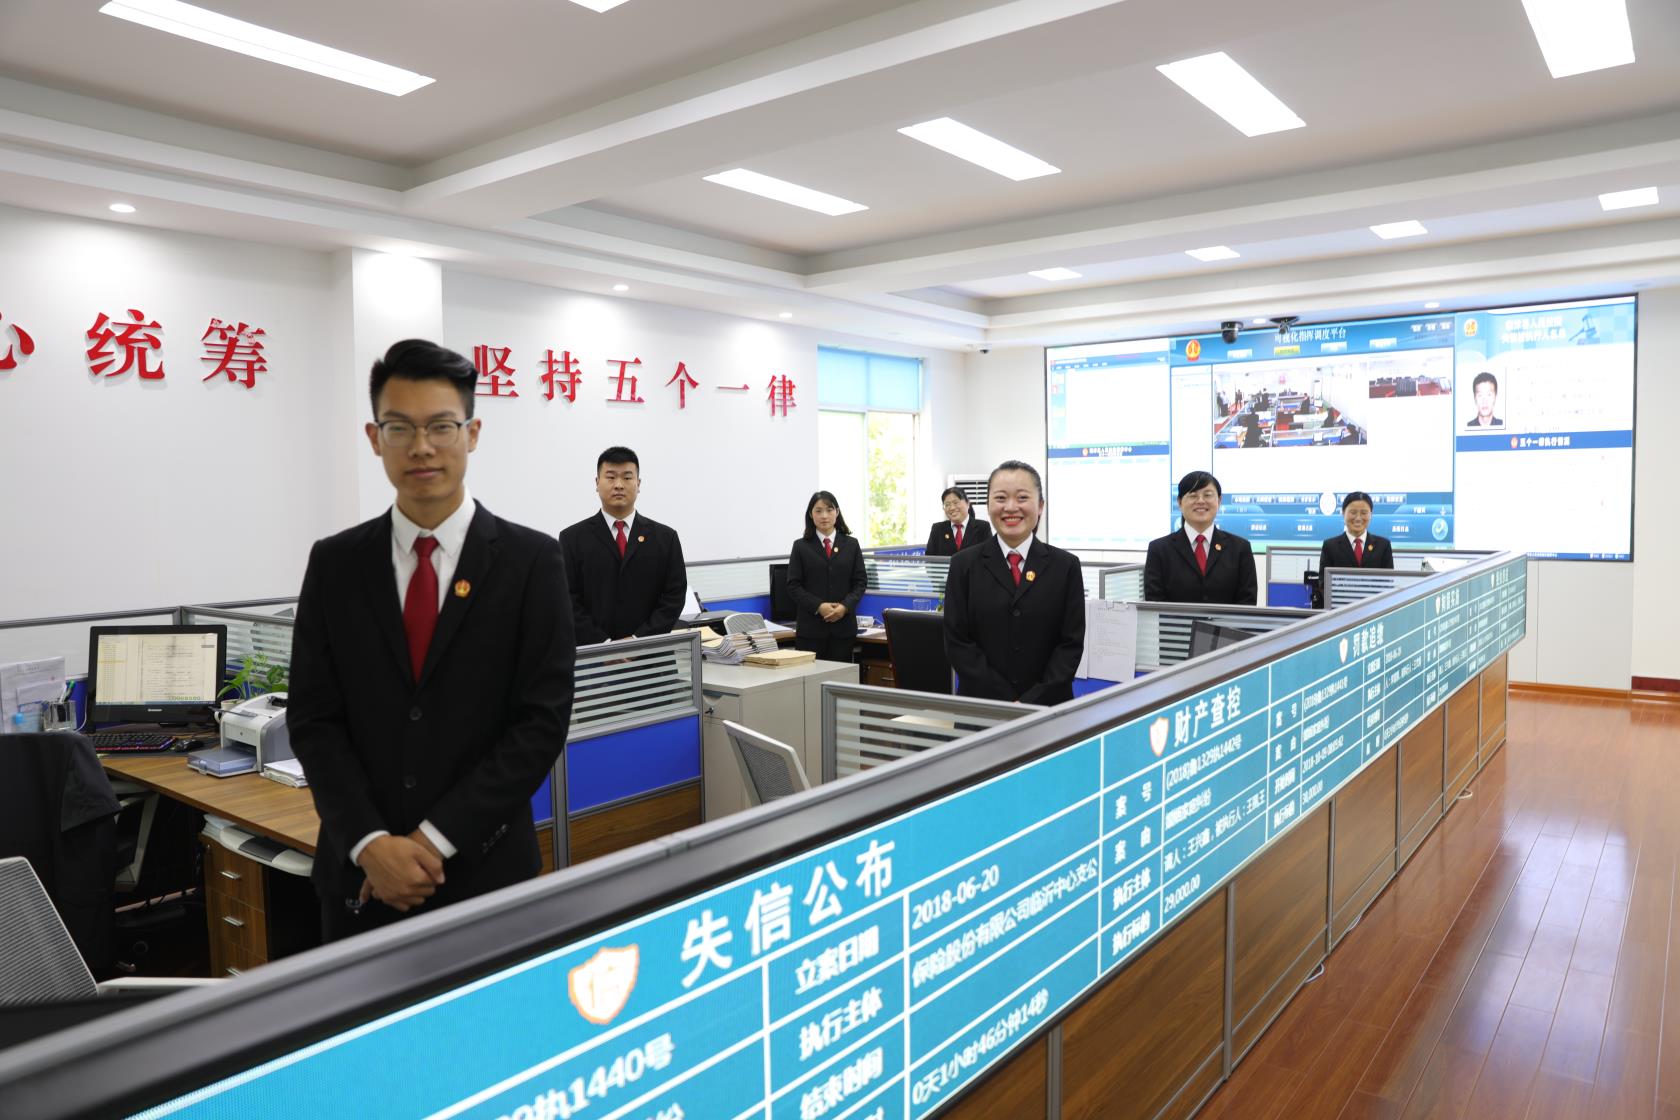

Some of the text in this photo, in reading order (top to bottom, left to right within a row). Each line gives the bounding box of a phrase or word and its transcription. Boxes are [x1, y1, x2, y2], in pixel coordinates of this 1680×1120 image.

[474, 344, 797, 418] 坚持五个一律
[1173, 685, 1241, 748] 财产查控
[1115, 781, 1152, 820] 案号
[1114, 825, 1151, 865] 案由
[680, 839, 896, 988] 失信公布
[911, 864, 1000, 931] 2018-06-20
[911, 857, 1099, 989] 保险股份有限公司临沂中心支公
[1112, 867, 1151, 911] 执行主体
[1164, 873, 1201, 914] 29,000.00
[794, 924, 880, 996] 立案日期
[1111, 909, 1151, 957] 执行标的
[799, 986, 884, 1062] 执行主体
[911, 987, 1050, 1106] 0天1小时46分钟14秒
[494, 1031, 676, 1120] 执1440号
[799, 1046, 884, 1120] 结束时间
